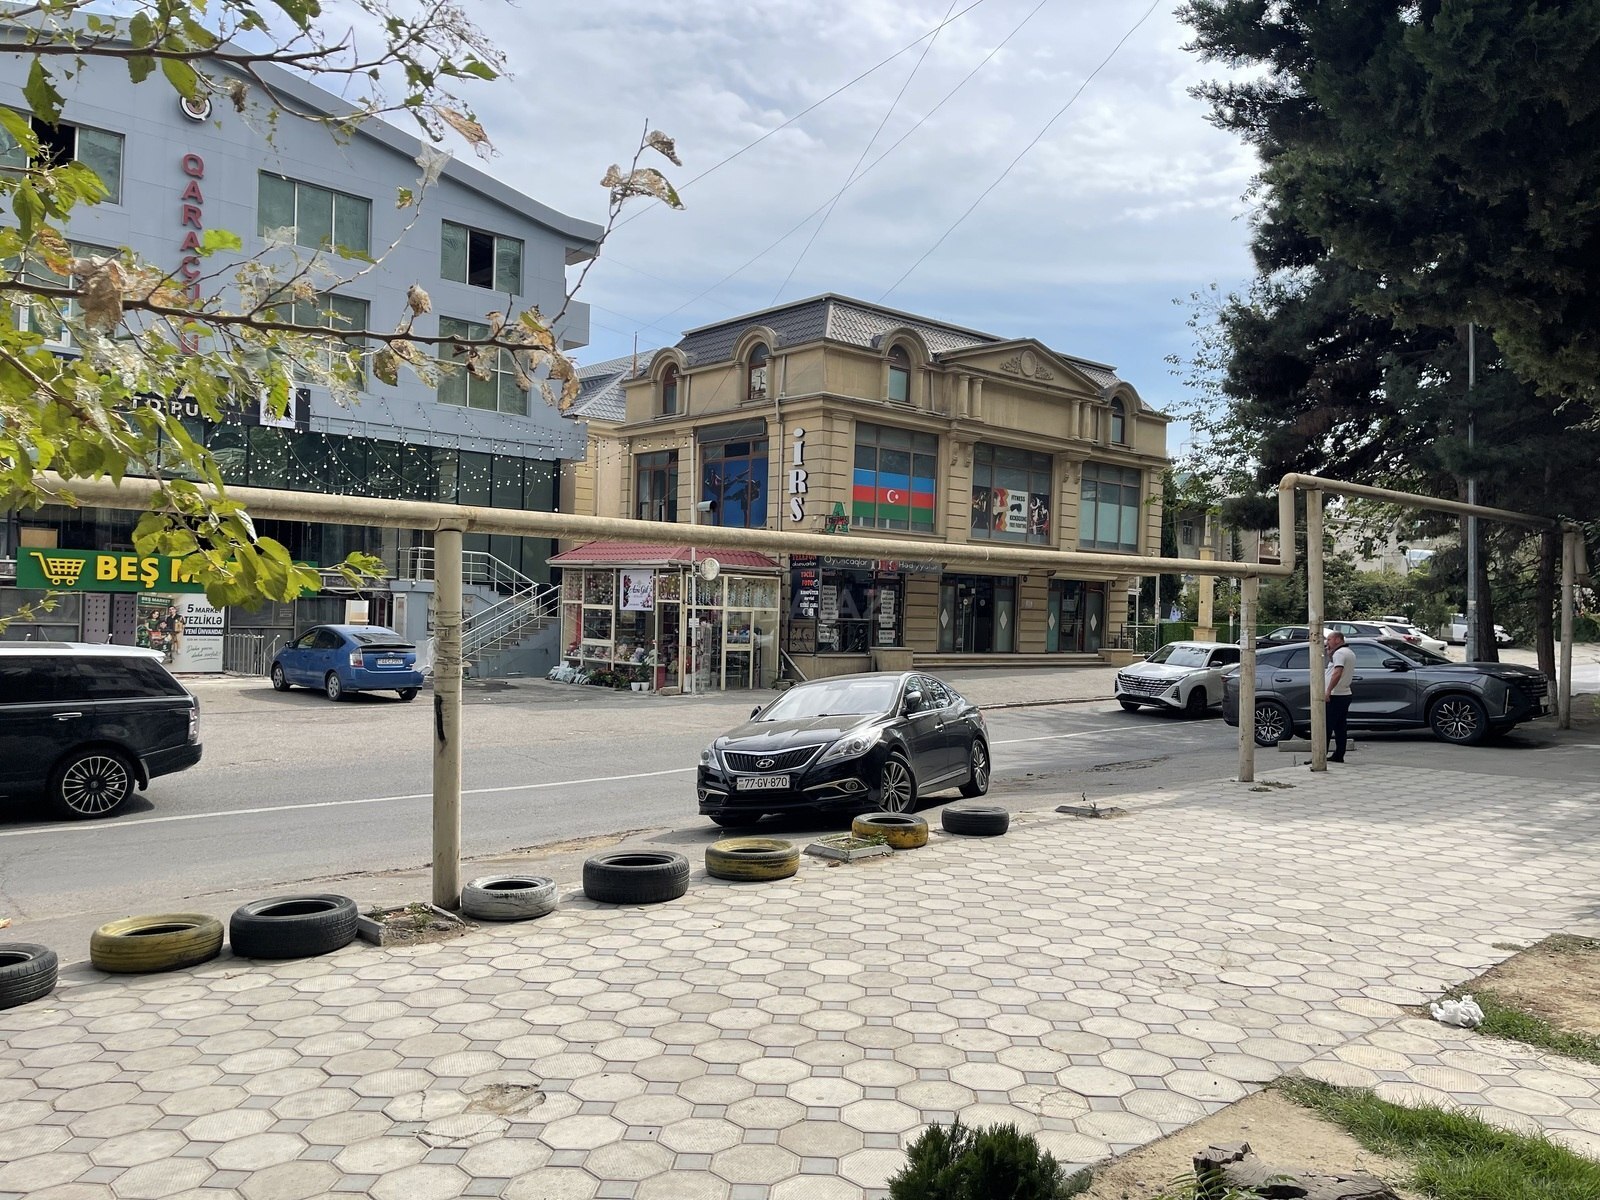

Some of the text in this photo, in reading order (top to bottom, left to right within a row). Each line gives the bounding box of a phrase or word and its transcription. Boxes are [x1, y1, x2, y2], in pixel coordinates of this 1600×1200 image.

[96, 555, 160, 589] BEŞ
[187, 603, 194, 613] 5
[184, 614, 223, 625] TEZLİKLƏ
[745, 777, 787, 788] 77-GV-870
